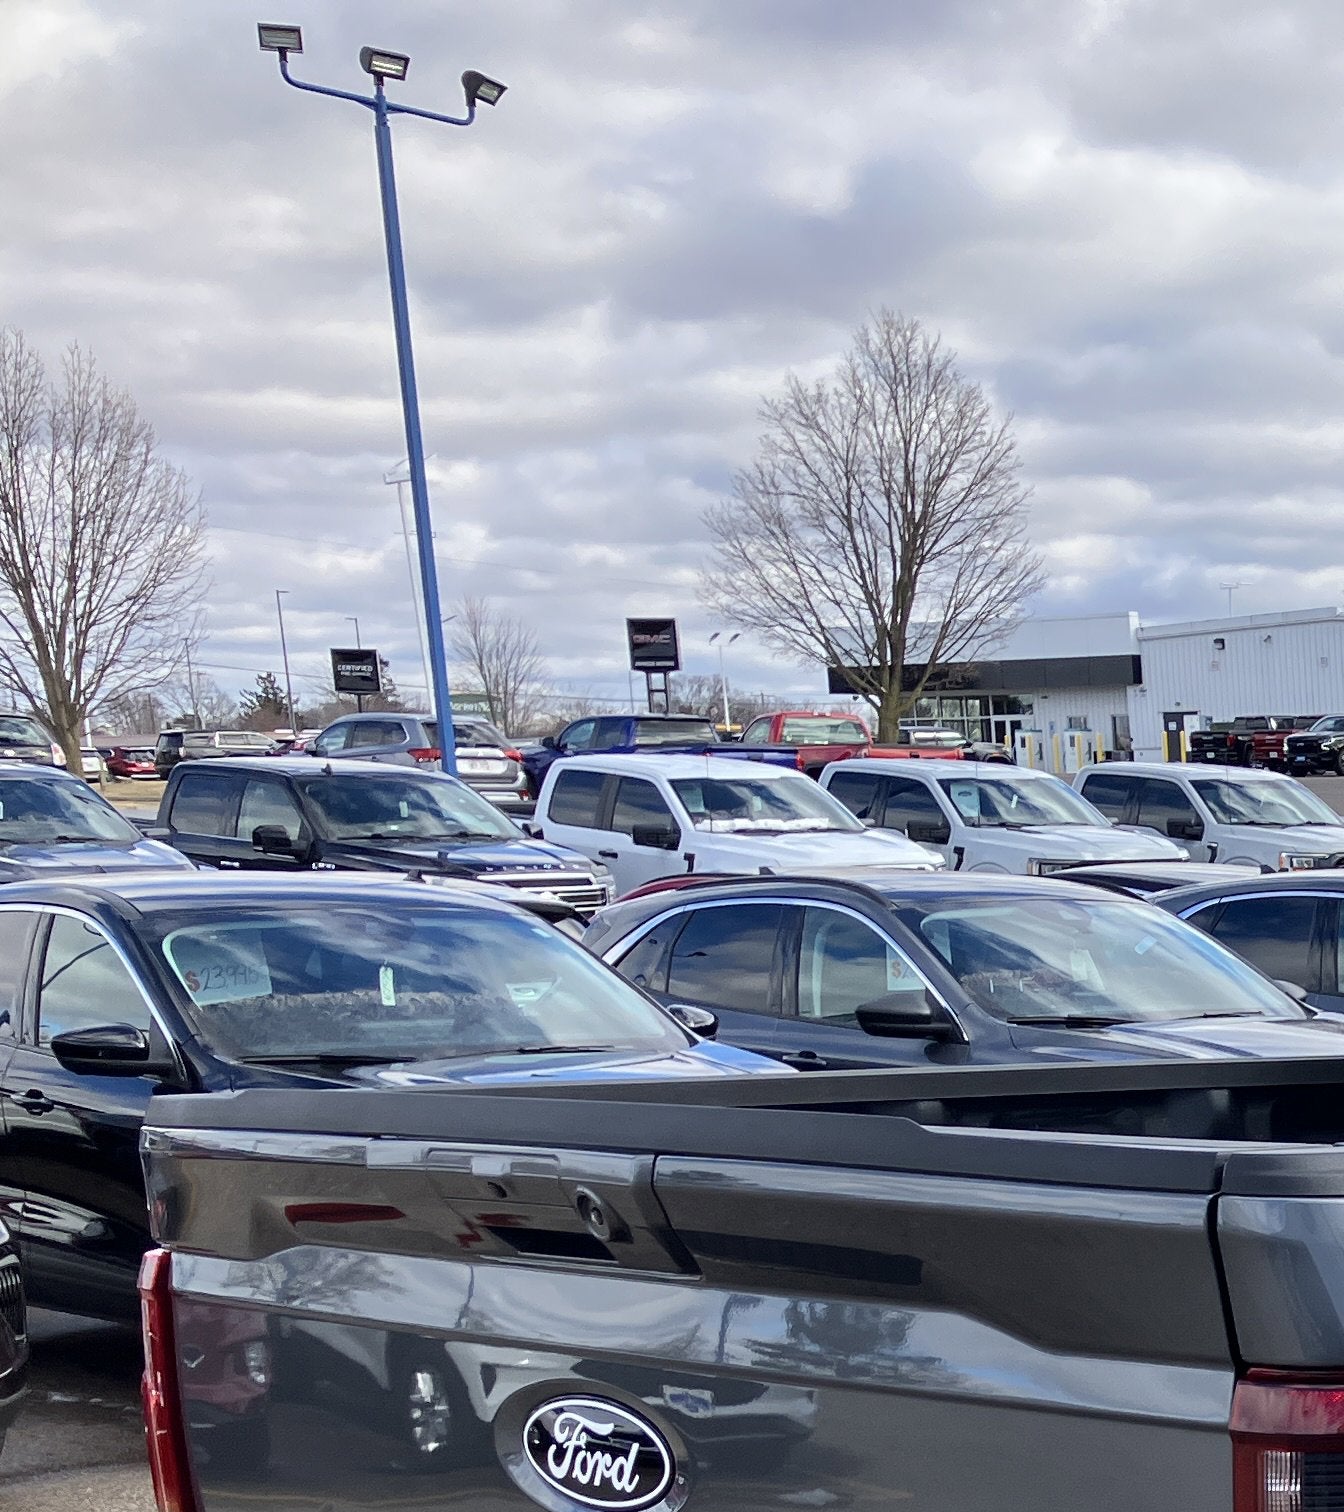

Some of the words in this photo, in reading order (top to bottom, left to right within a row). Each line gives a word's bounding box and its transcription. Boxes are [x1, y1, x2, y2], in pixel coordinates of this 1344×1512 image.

[632, 634, 671, 643] GMC
[337, 664, 373, 672] CERTIFIED
[547, 1412, 640, 1493] Ford
